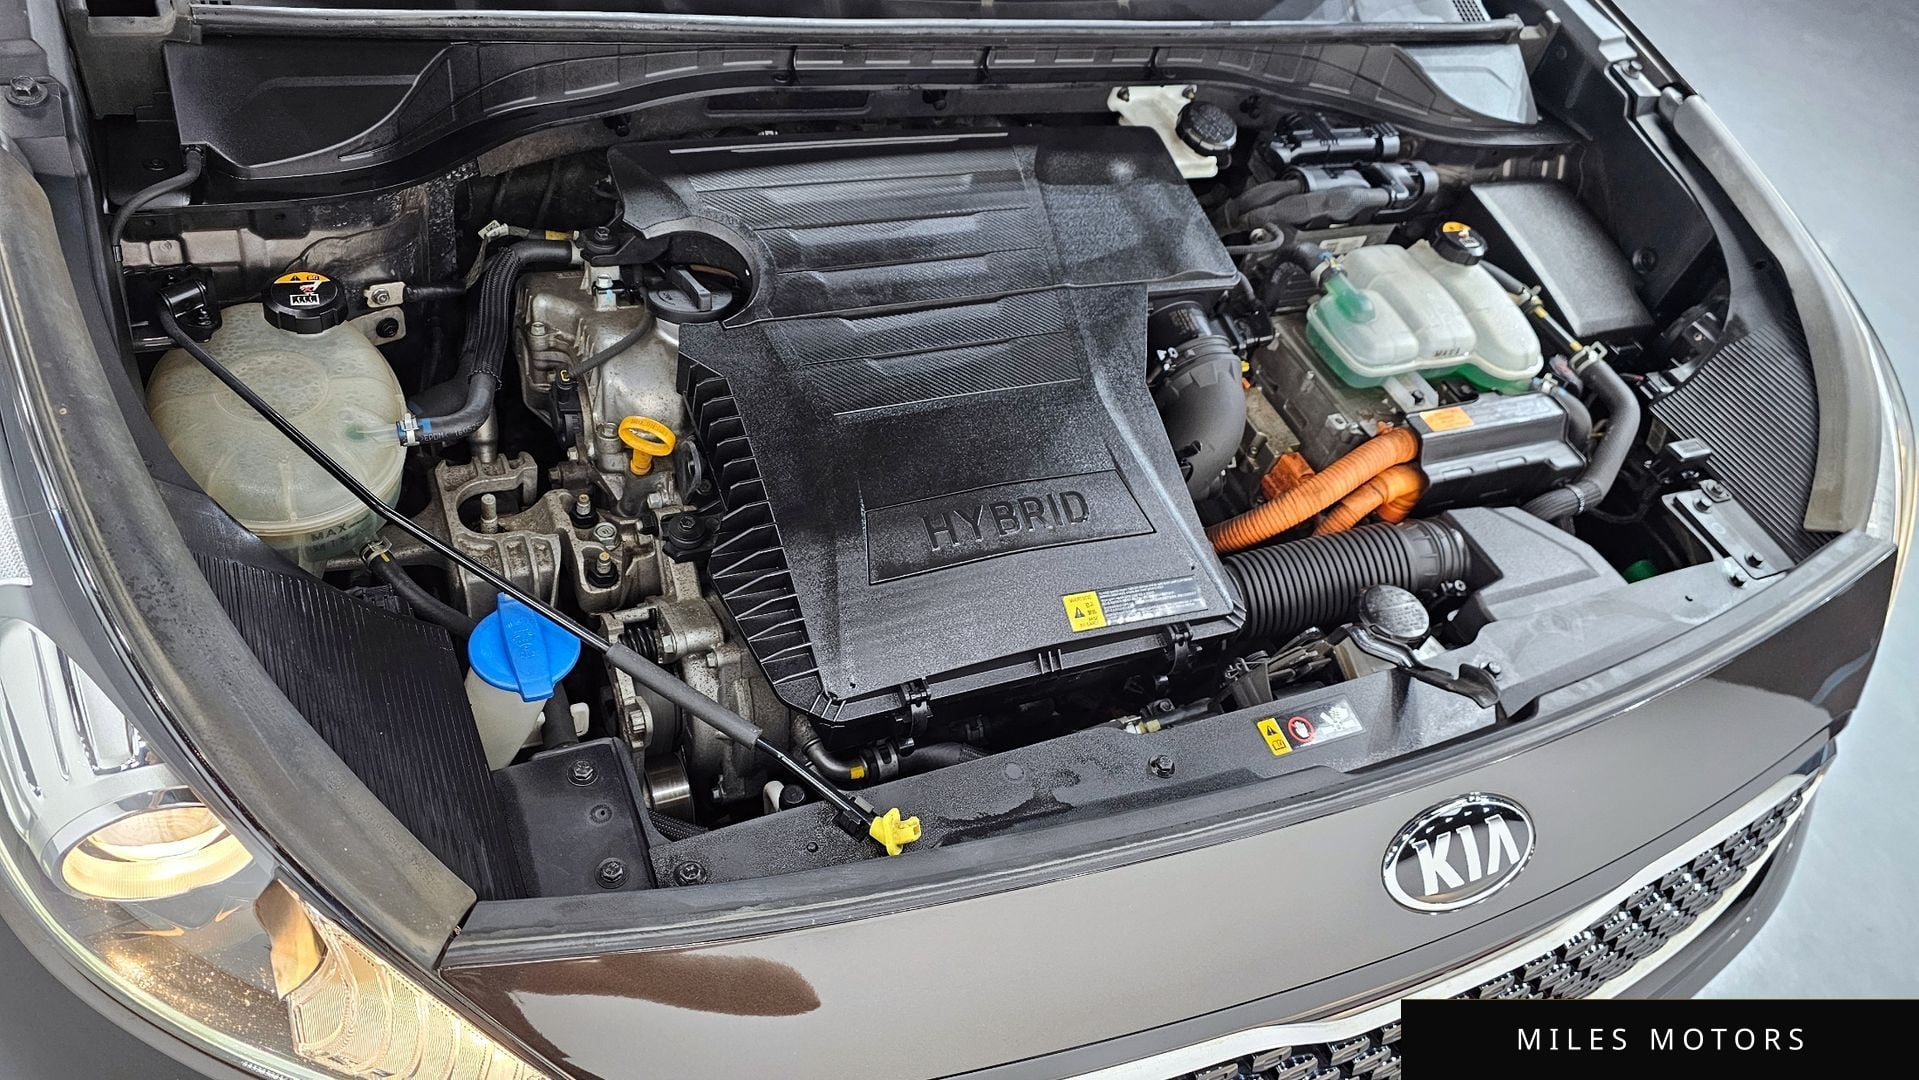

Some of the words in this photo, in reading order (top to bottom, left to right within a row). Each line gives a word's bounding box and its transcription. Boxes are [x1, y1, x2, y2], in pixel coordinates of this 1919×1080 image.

[310, 522, 348, 542] MAX
[921, 490, 1091, 552] HYBRID
[1411, 813, 1521, 897] KIA
